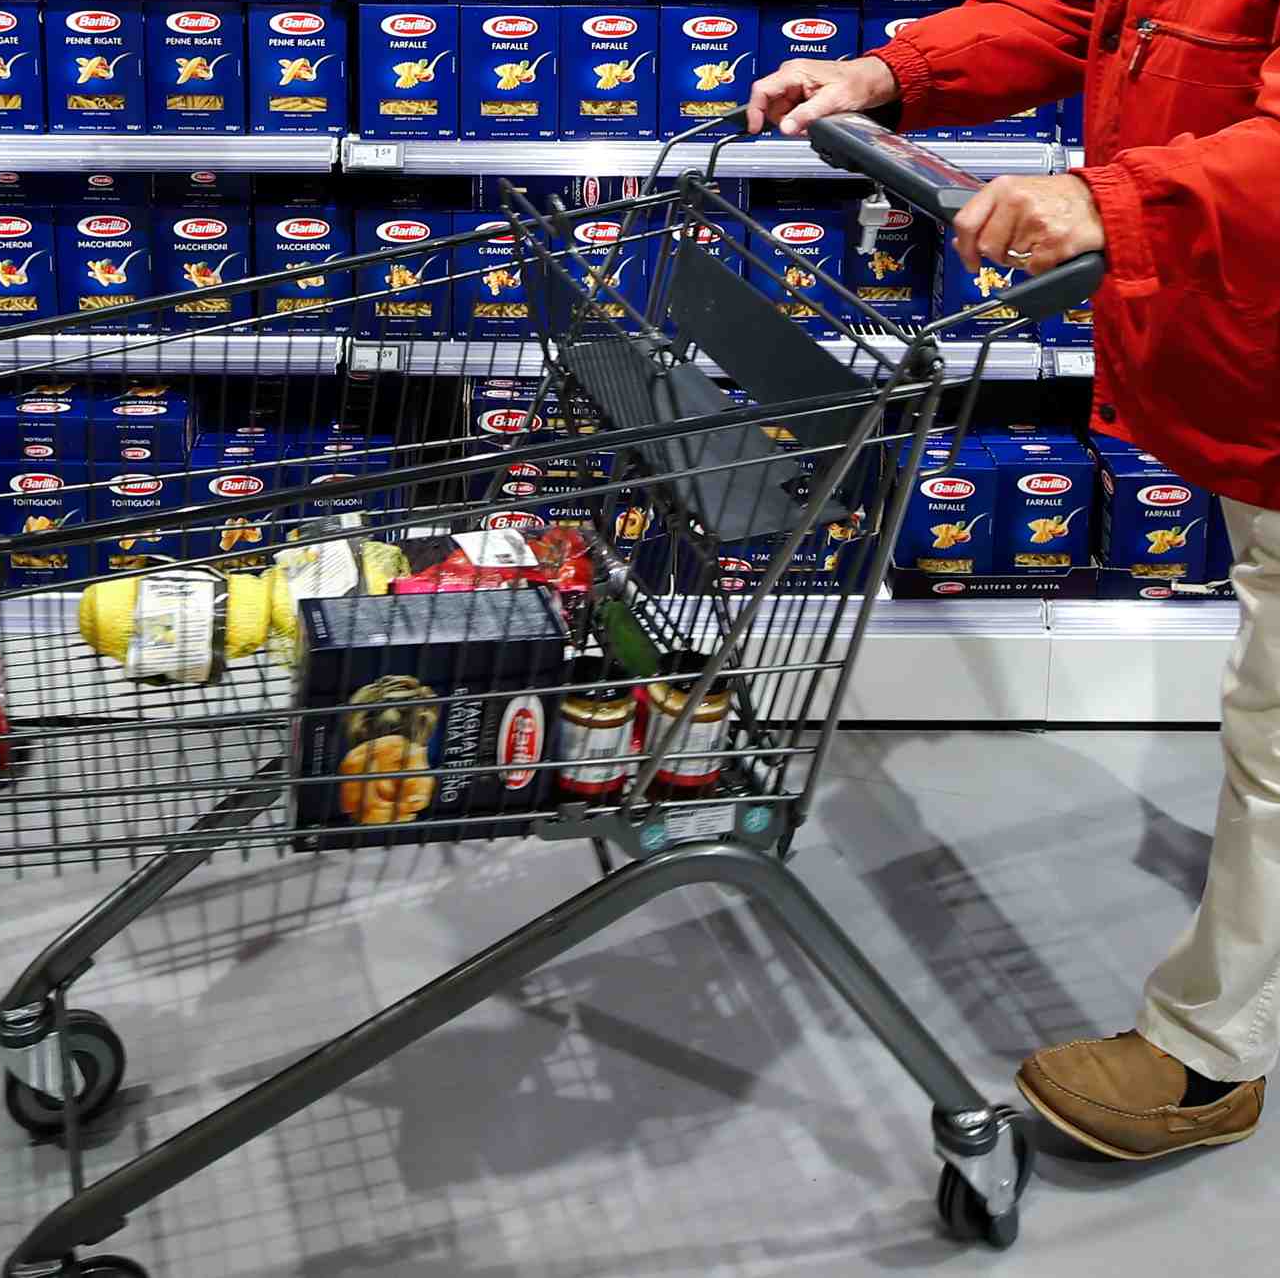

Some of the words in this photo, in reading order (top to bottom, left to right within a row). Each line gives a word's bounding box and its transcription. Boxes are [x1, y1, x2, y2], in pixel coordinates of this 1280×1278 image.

[77, 15, 116, 28] Barilla
[281, 17, 320, 30] Barilla
[394, 19, 433, 32] Barilla
[695, 21, 734, 34] Barilla
[65, 37, 91, 46] PENNE
[94, 37, 123, 46] RIGATE
[269, 38, 295, 47] PENNE
[297, 38, 326, 47] RIGATE
[390, 40, 427, 50] FARFALLE
[691, 42, 728, 51] FARFALLE
[389, 224, 426, 238] Barilla
[782, 226, 818, 239] Barilla
[1029, 478, 1068, 491] Barilla
[1025, 498, 1063, 507] FARFALLE
[970, 582, 1012, 591] MASTERS
[1016, 582, 1028, 590] OF
[1032, 582, 1060, 590] PASTA
